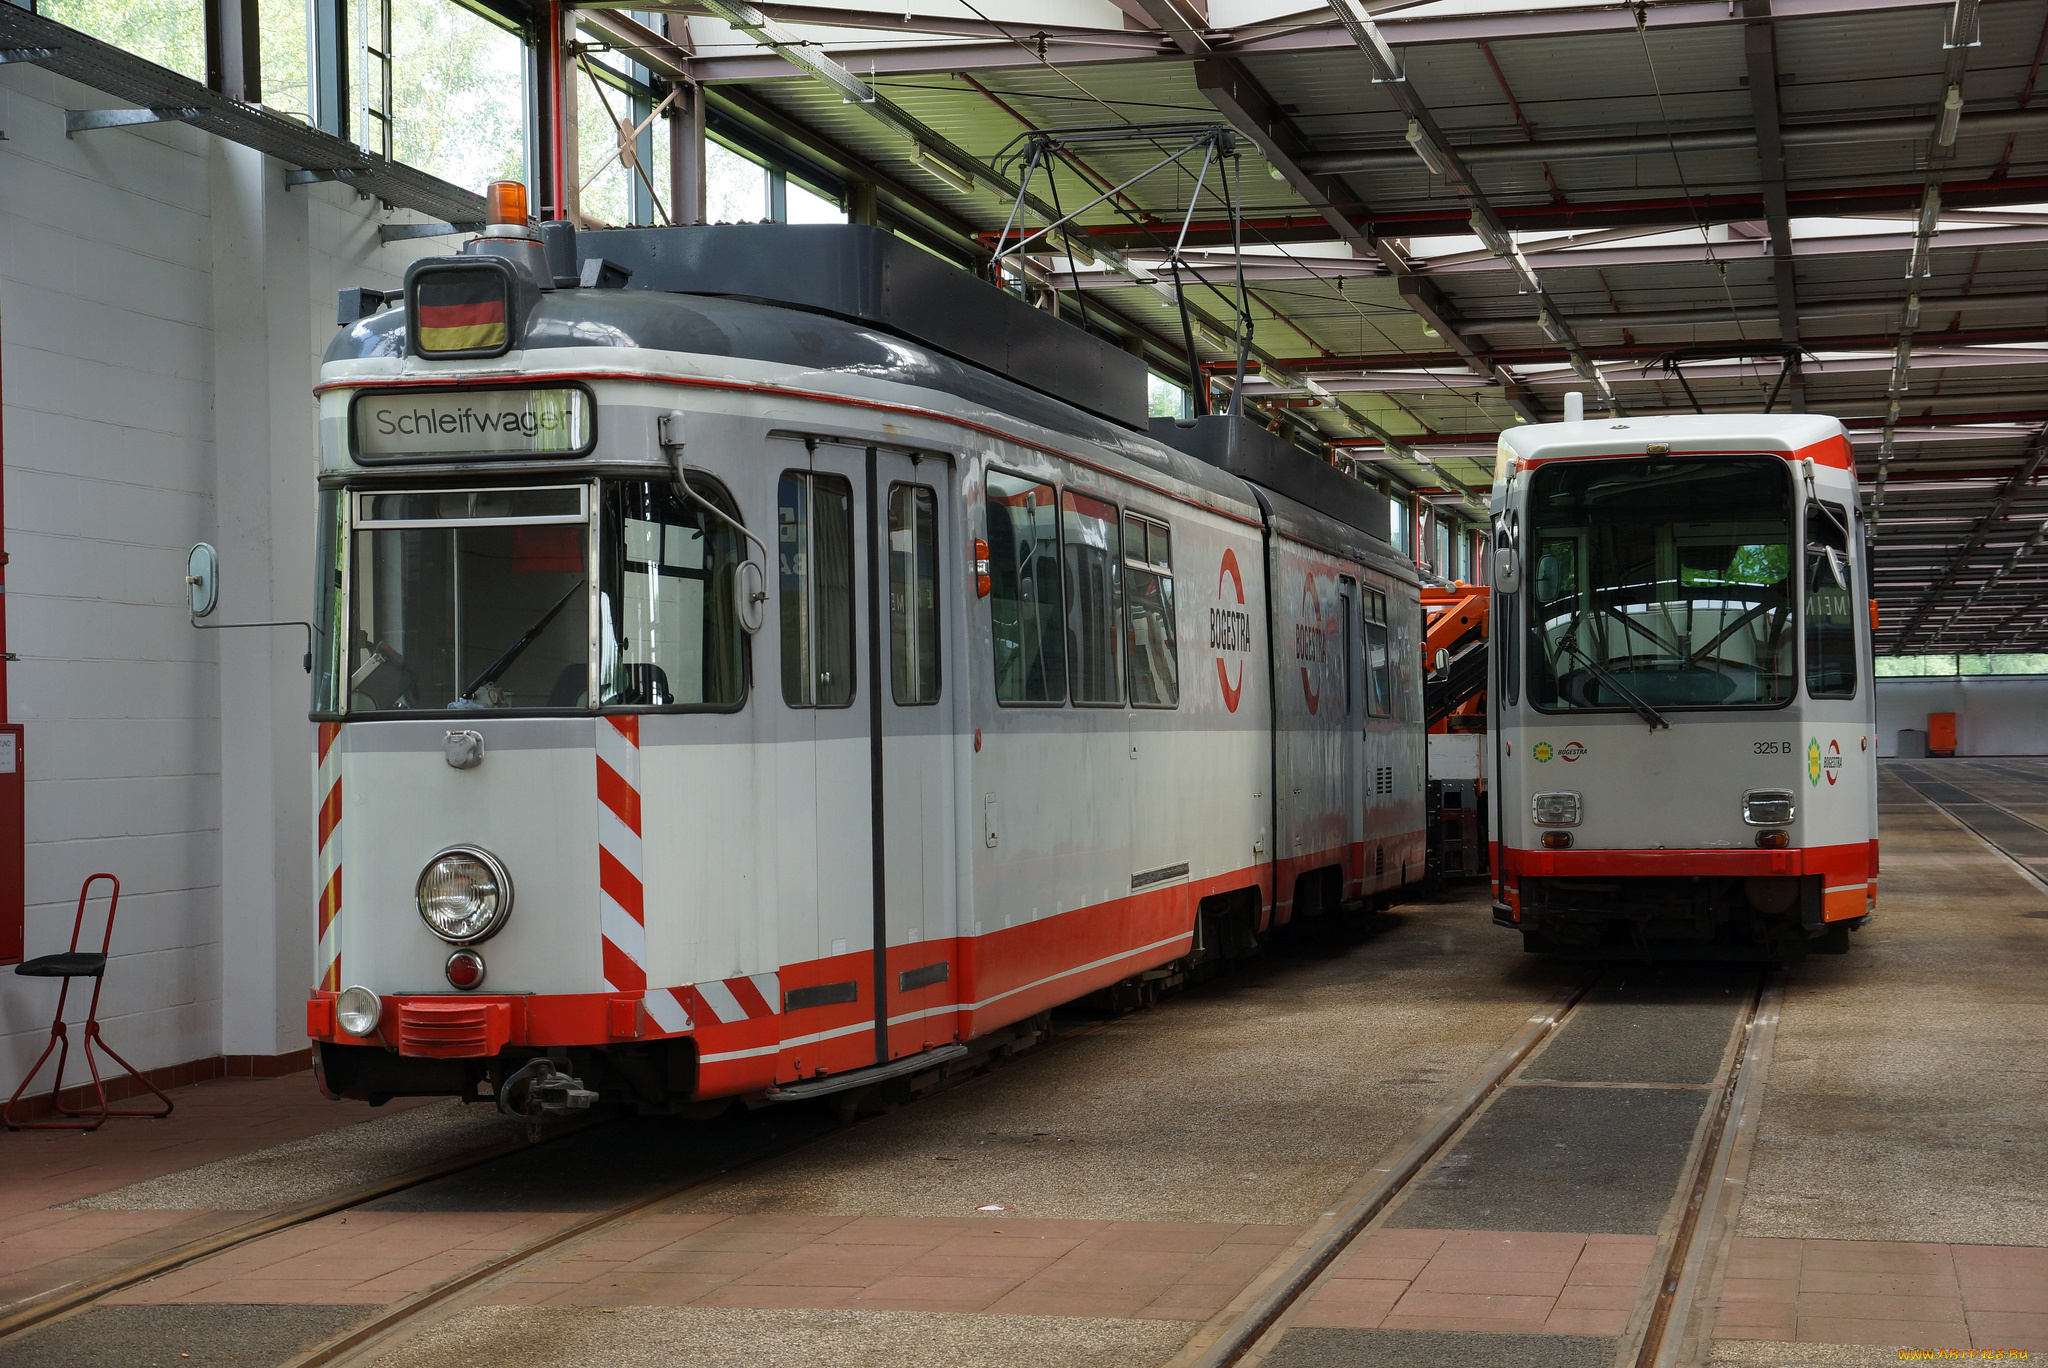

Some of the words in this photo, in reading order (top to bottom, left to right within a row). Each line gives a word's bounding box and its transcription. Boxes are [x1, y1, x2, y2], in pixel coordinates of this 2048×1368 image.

[1210, 607, 1251, 652] BOGESTRA
[1557, 748, 1588, 756] BOGESTRA
[1753, 741, 1779, 755] 325
[1782, 741, 1792, 754] B
